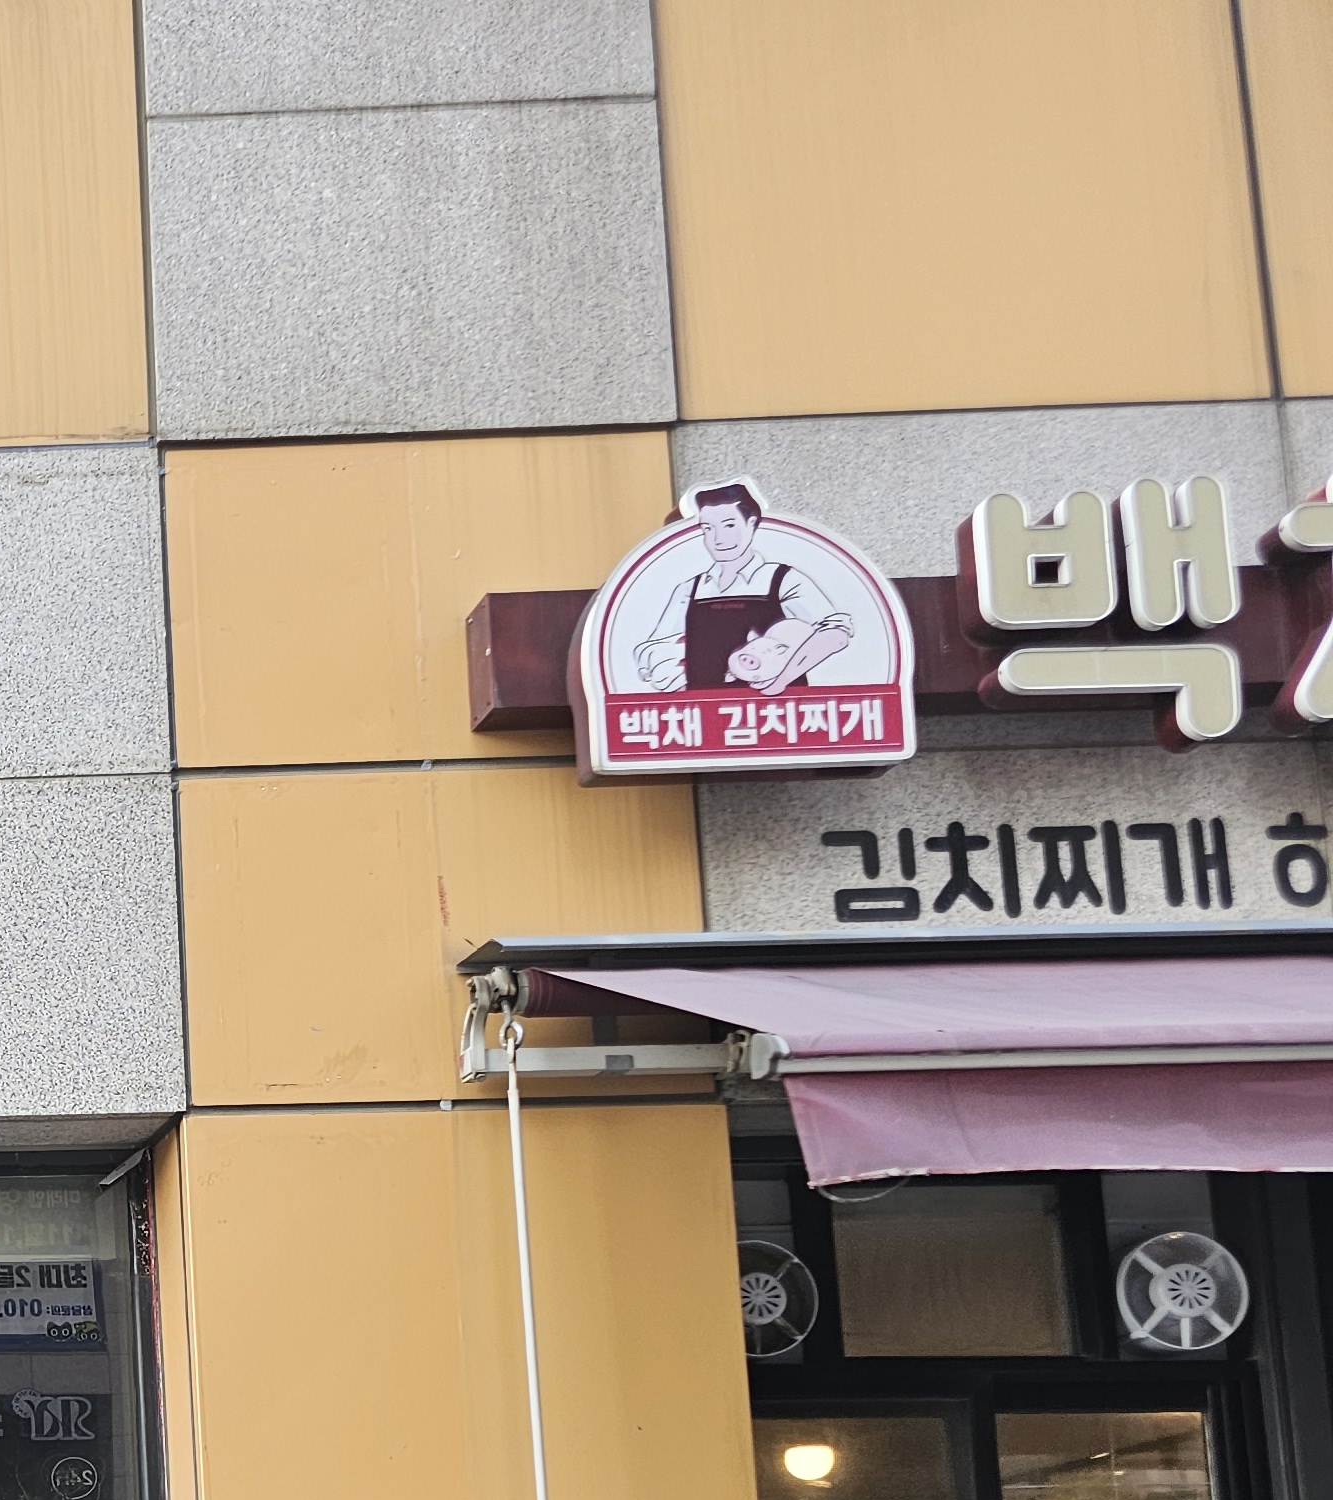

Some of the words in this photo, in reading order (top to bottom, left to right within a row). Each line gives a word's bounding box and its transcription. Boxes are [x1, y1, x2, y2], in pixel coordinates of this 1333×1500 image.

[971, 474, 1333, 744] 백
[618, 701, 703, 751] 백채
[723, 696, 885, 748] 김치찌개
[821, 815, 1234, 923] 김치찌개
